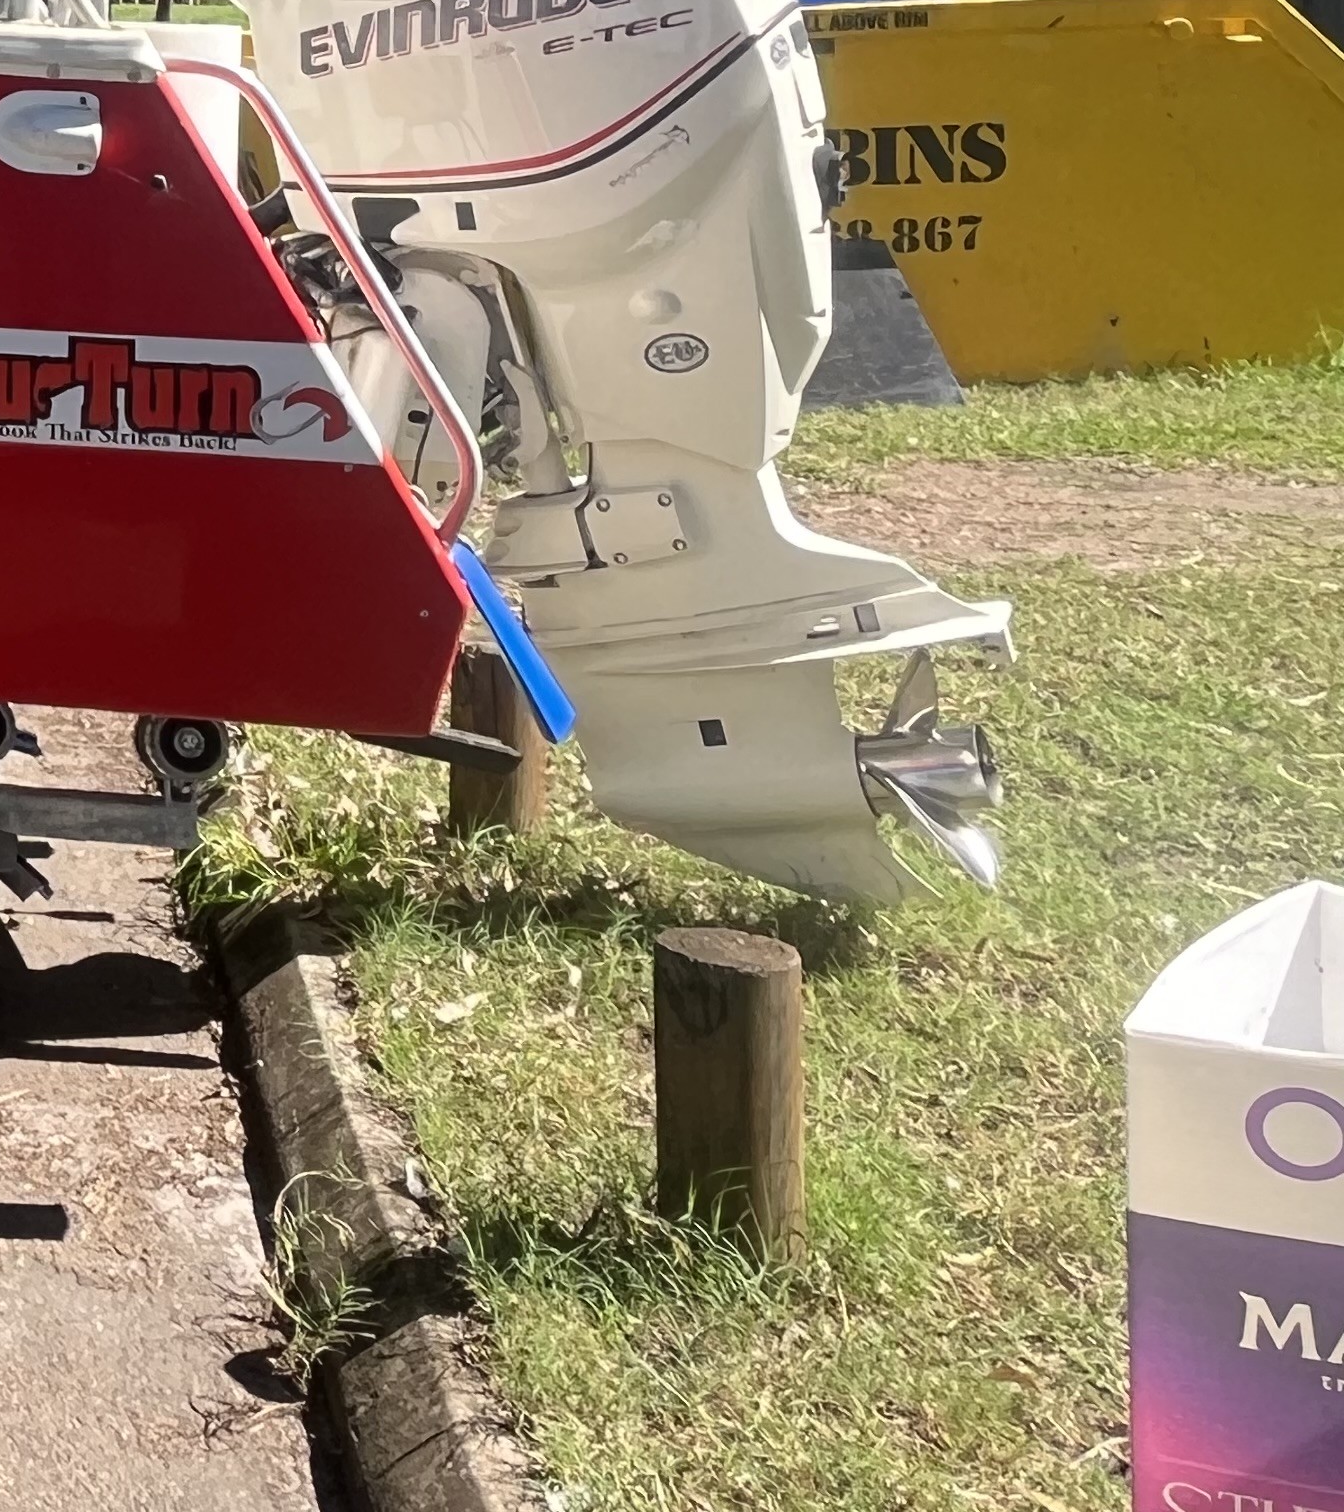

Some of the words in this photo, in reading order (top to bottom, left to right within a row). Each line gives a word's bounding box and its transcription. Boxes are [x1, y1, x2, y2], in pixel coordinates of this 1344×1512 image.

[542, 9, 694, 56] E-TEC
[828, 11, 888, 32] ABOVE
[824, 122, 1007, 186] BINS
[892, 215, 983, 253] 867
[45, 423, 91, 442] That
[98, 430, 171, 447] Strikes
[179, 434, 237, 451] Back!
